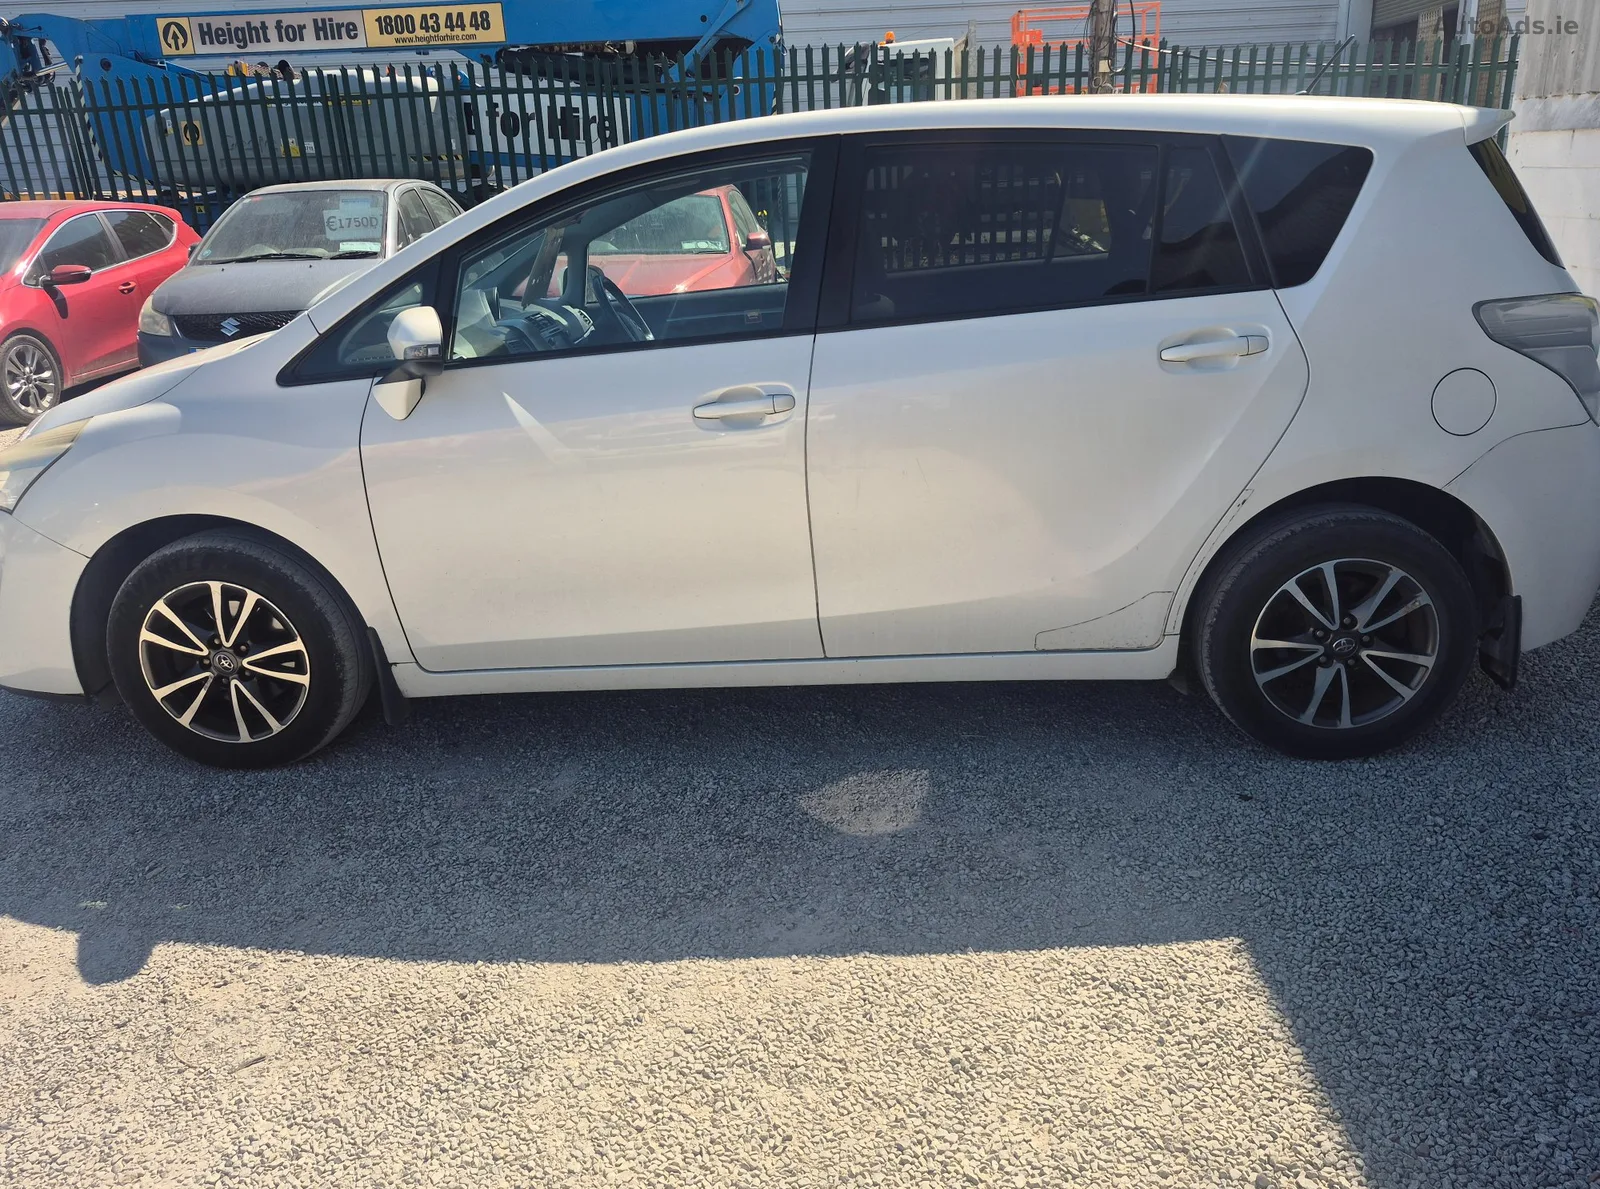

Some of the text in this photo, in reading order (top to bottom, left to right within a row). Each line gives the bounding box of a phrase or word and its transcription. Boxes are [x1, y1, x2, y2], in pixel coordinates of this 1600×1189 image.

[198, 17, 358, 49] Height for Hire
[375, 10, 491, 35] 1800 43 44 48
[394, 33, 477, 44] www.heightforhire.com
